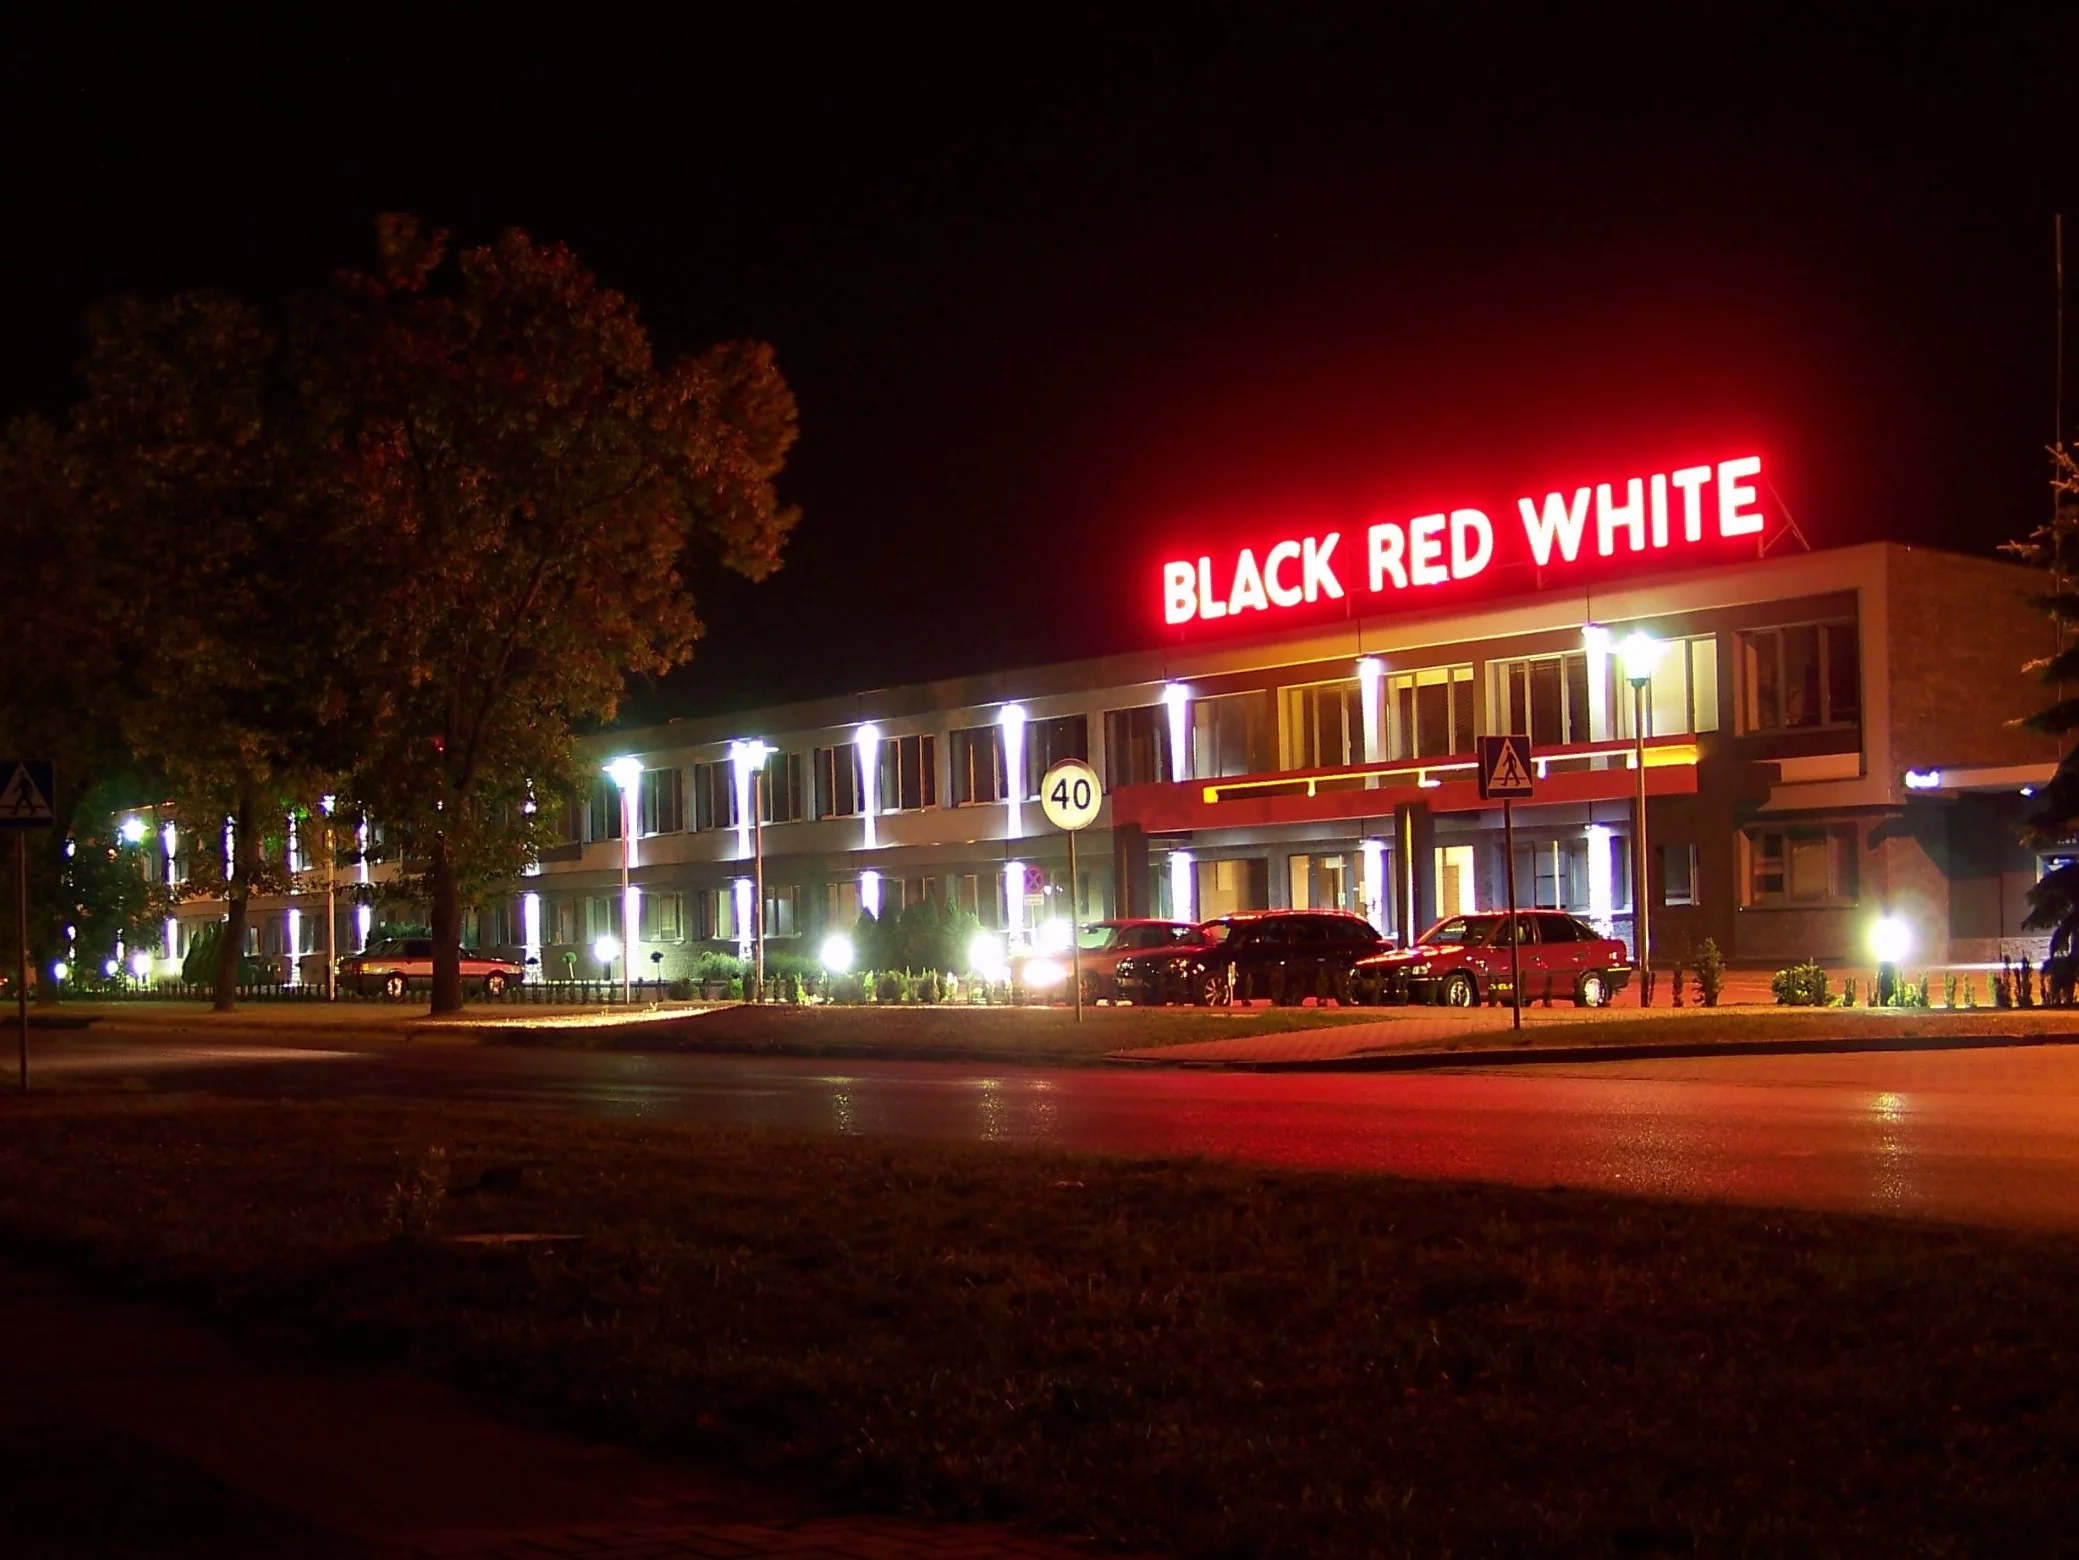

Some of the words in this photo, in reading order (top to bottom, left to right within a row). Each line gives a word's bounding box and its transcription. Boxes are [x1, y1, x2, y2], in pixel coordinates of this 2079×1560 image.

[1163, 532, 1345, 625] BLACK
[1367, 508, 1495, 592] RED
[1518, 456, 1764, 566] WHITE
[1051, 778, 1091, 810] 40
